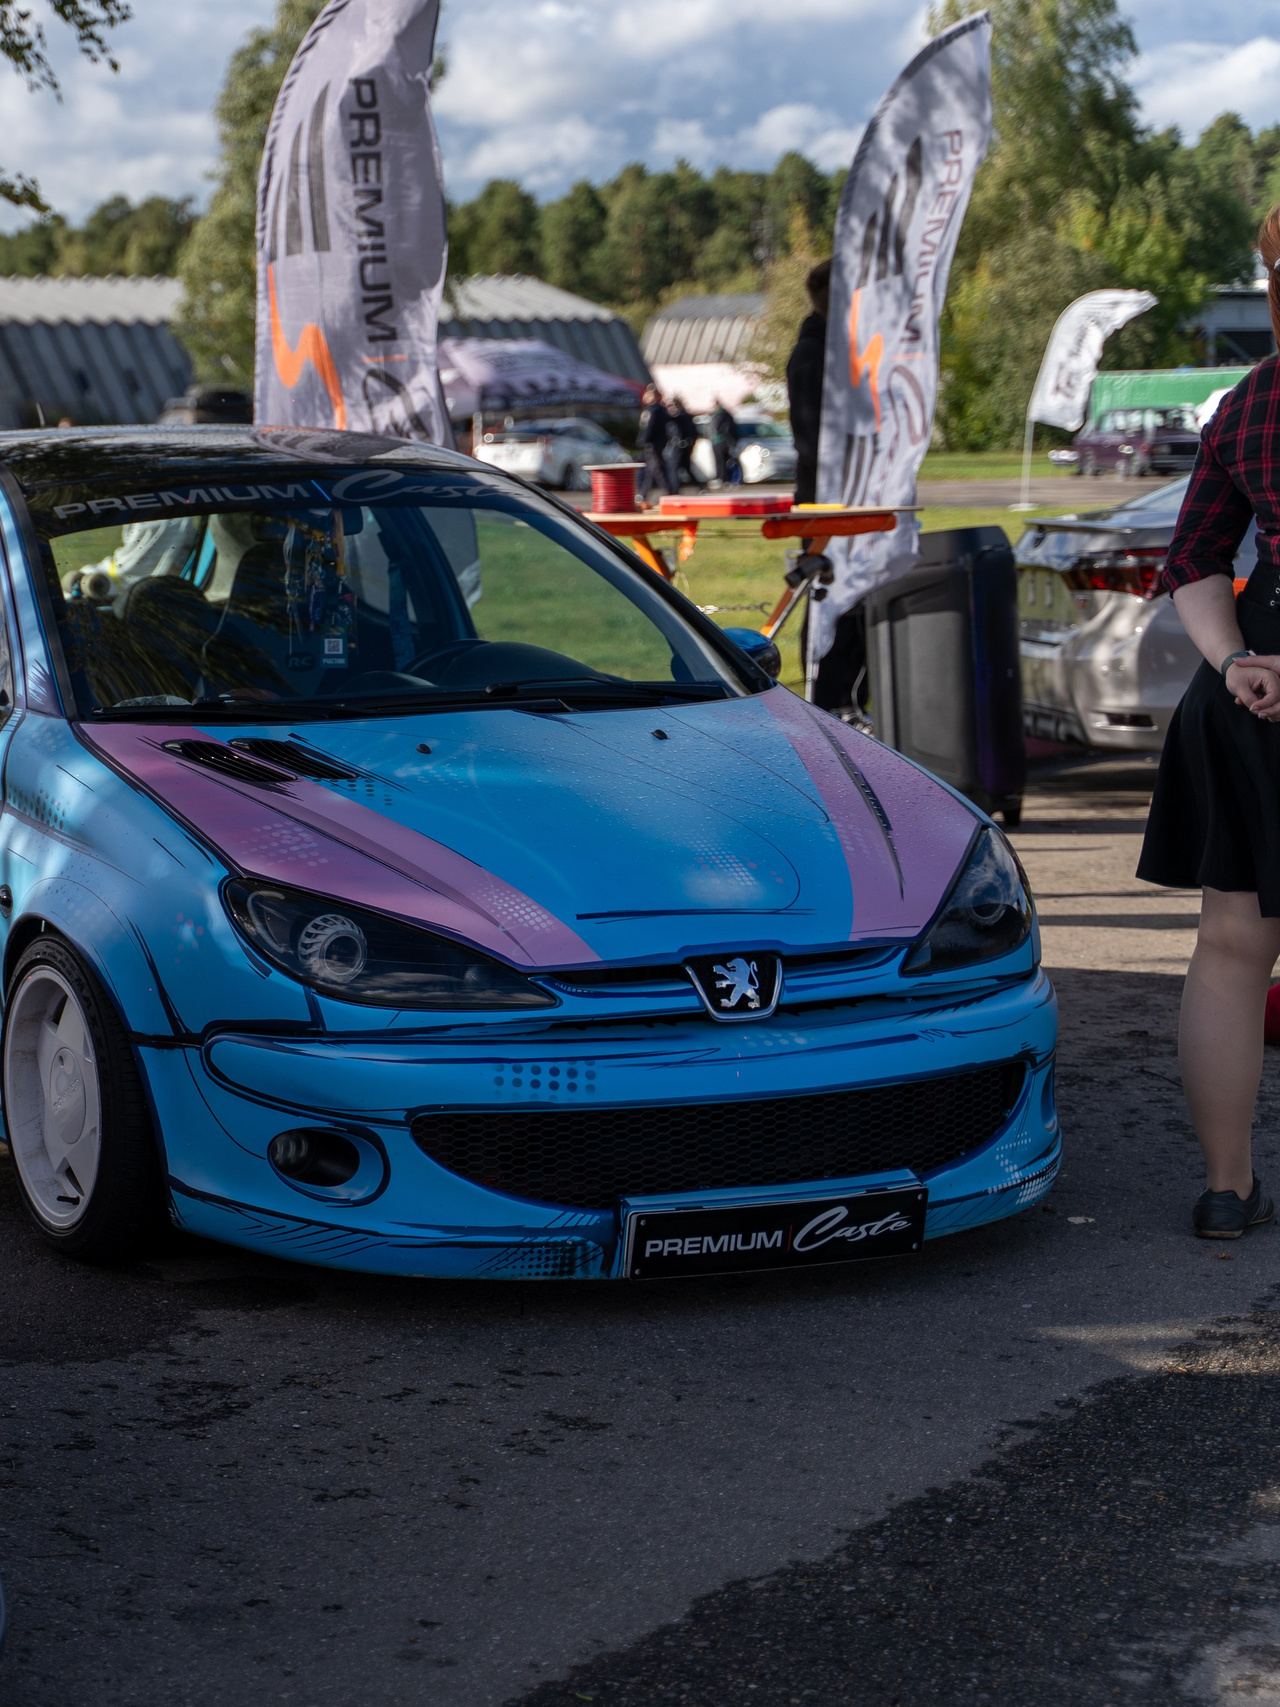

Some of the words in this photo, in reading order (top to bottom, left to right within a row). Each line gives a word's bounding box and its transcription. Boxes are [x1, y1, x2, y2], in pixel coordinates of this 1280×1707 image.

[348, 77, 398, 343] PREMIUM
[898, 129, 964, 345] PREMIUM
[53, 483, 310, 520] PREMIUM
[645, 1230, 783, 1257] PREMIUM
[793, 1206, 912, 1251] Caste
